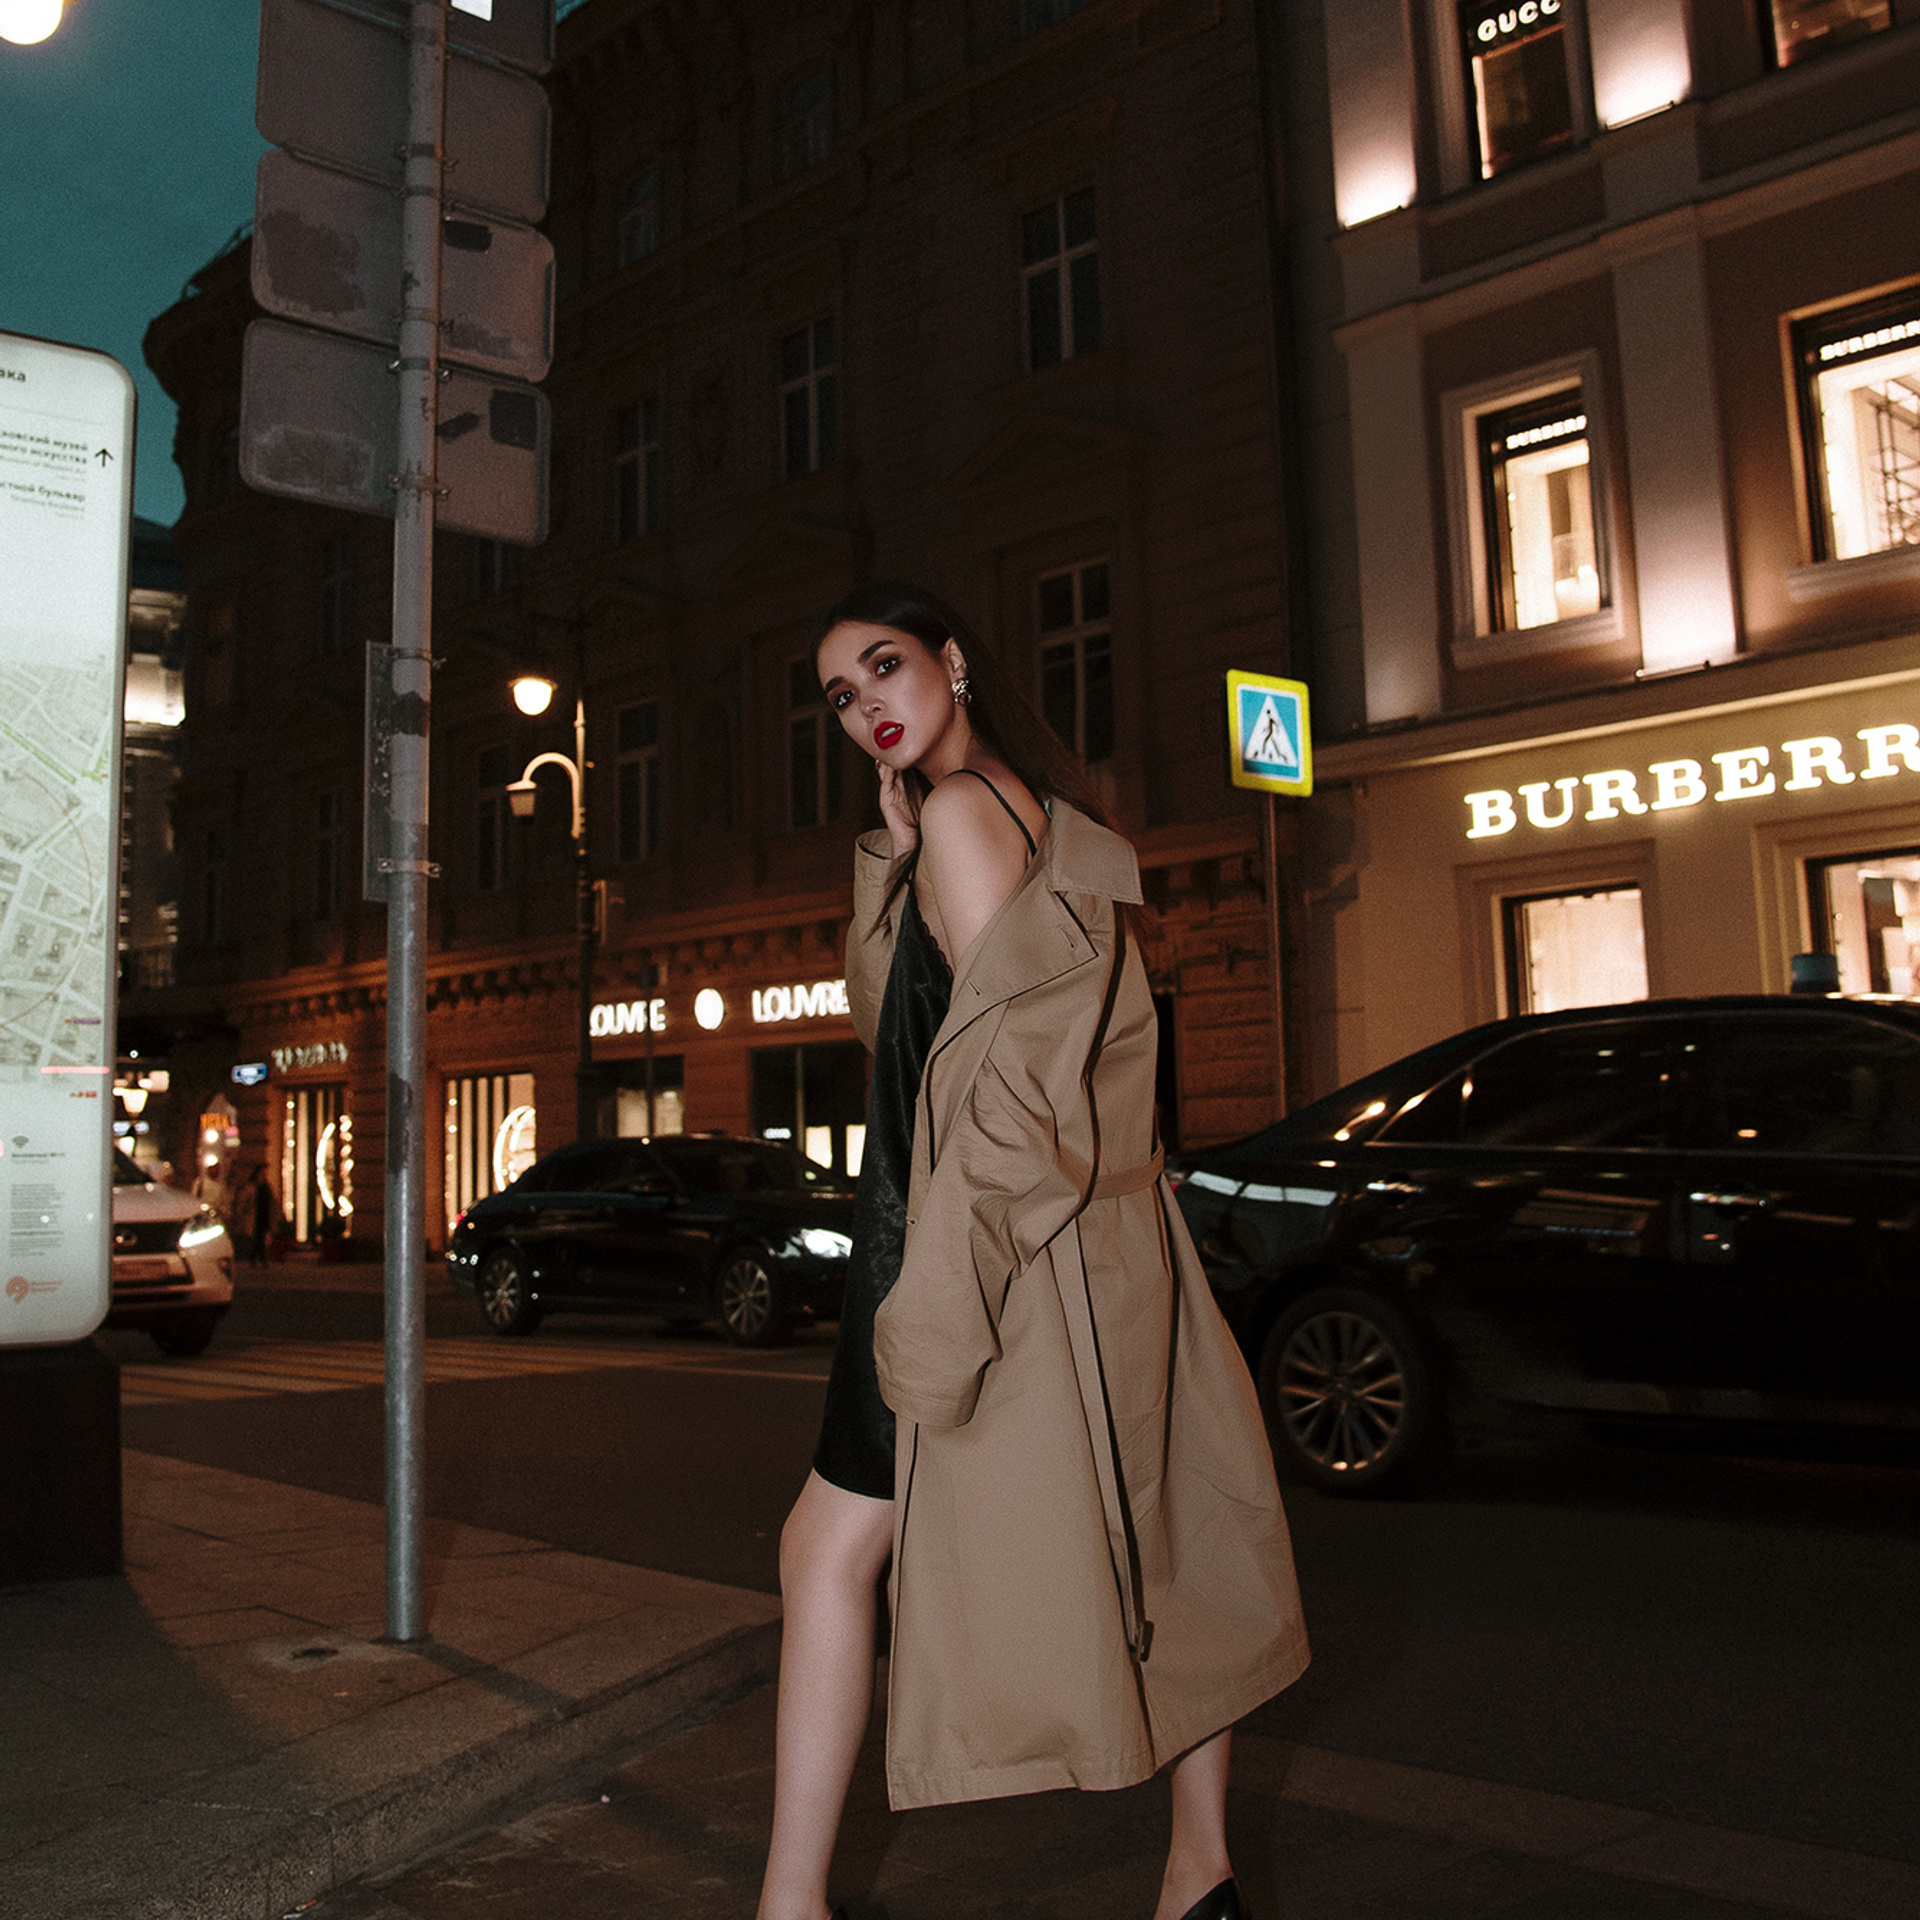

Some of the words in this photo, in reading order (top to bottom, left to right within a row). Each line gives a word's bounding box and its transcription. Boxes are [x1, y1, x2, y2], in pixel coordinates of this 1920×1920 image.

[1477, 0, 1561, 42] GUCC
[1464, 722, 1920, 839] BURBERR
[751, 978, 851, 1024] LOUVRE
